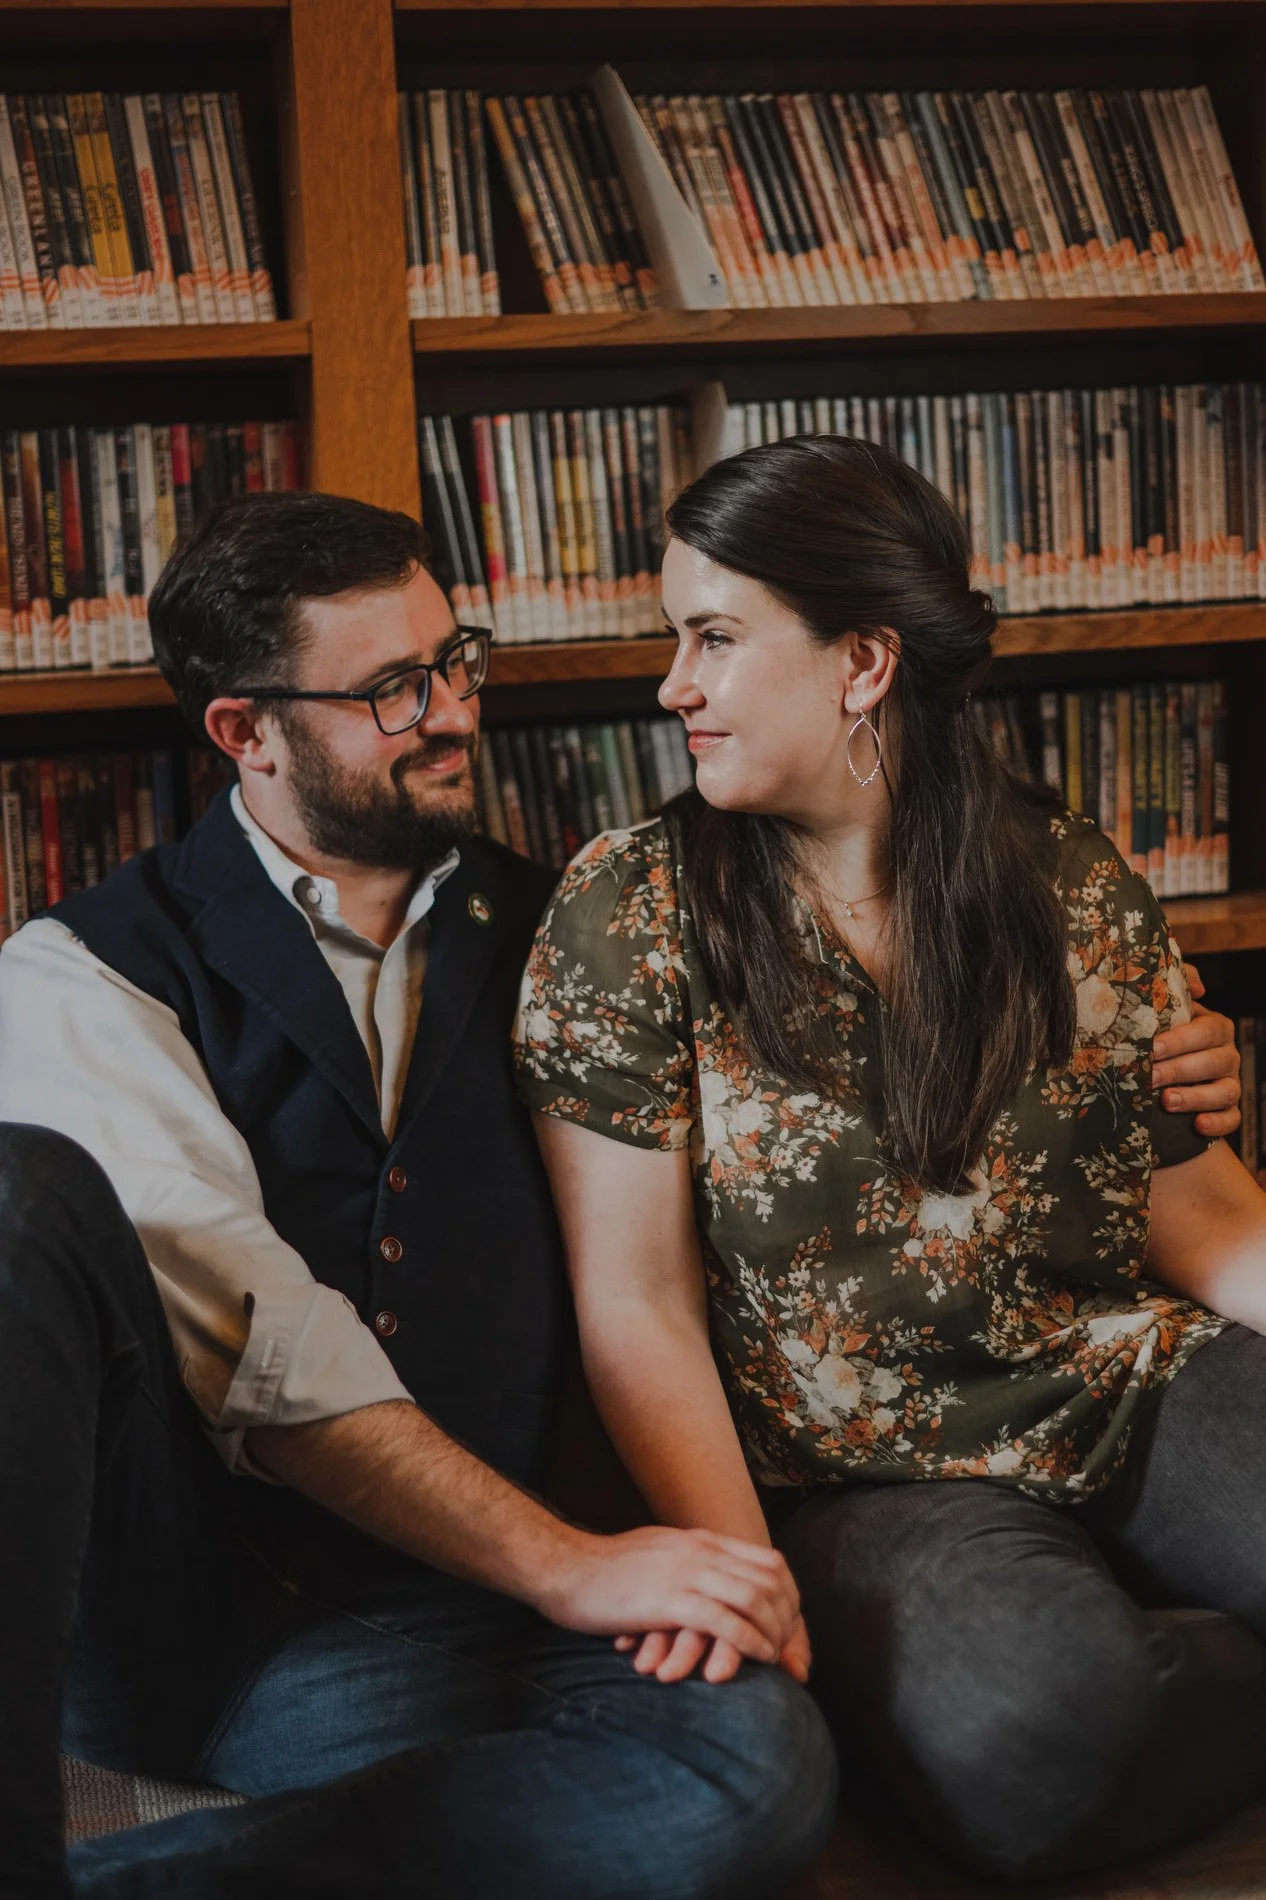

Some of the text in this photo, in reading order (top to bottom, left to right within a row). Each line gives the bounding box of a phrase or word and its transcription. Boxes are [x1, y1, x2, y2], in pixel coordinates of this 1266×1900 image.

[6, 175, 33, 263] GREEN BOOK
[83, 184, 105, 235] Greta
[99, 182, 125, 233] Greta
